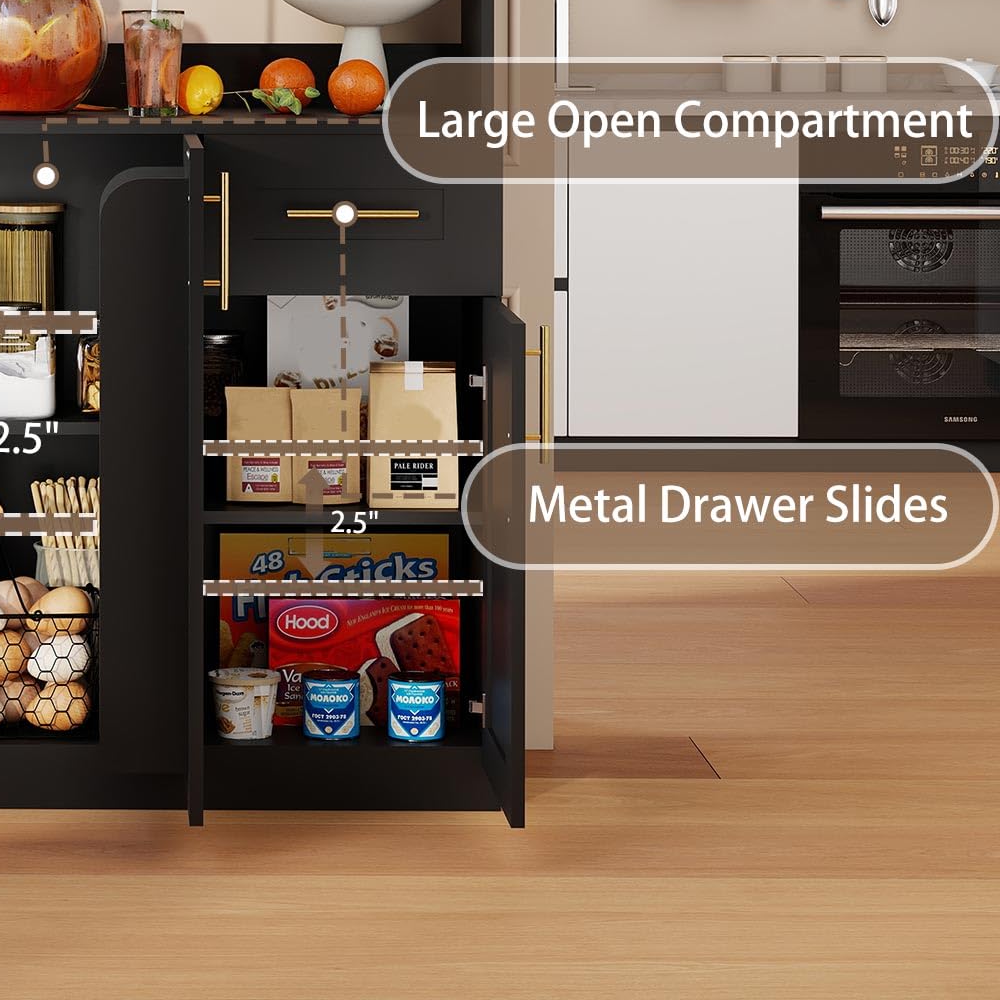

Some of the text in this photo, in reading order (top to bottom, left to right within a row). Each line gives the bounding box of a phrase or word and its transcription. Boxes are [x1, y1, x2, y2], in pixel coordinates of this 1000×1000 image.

[393, 462, 434, 470] PALE RIDER
[252, 551, 284, 573] 48
[284, 614, 330, 630] Hood
[287, 683, 301, 692] Ice
[310, 693, 349, 703] МОЛОКО
[395, 695, 435, 705] МОЛОКО
